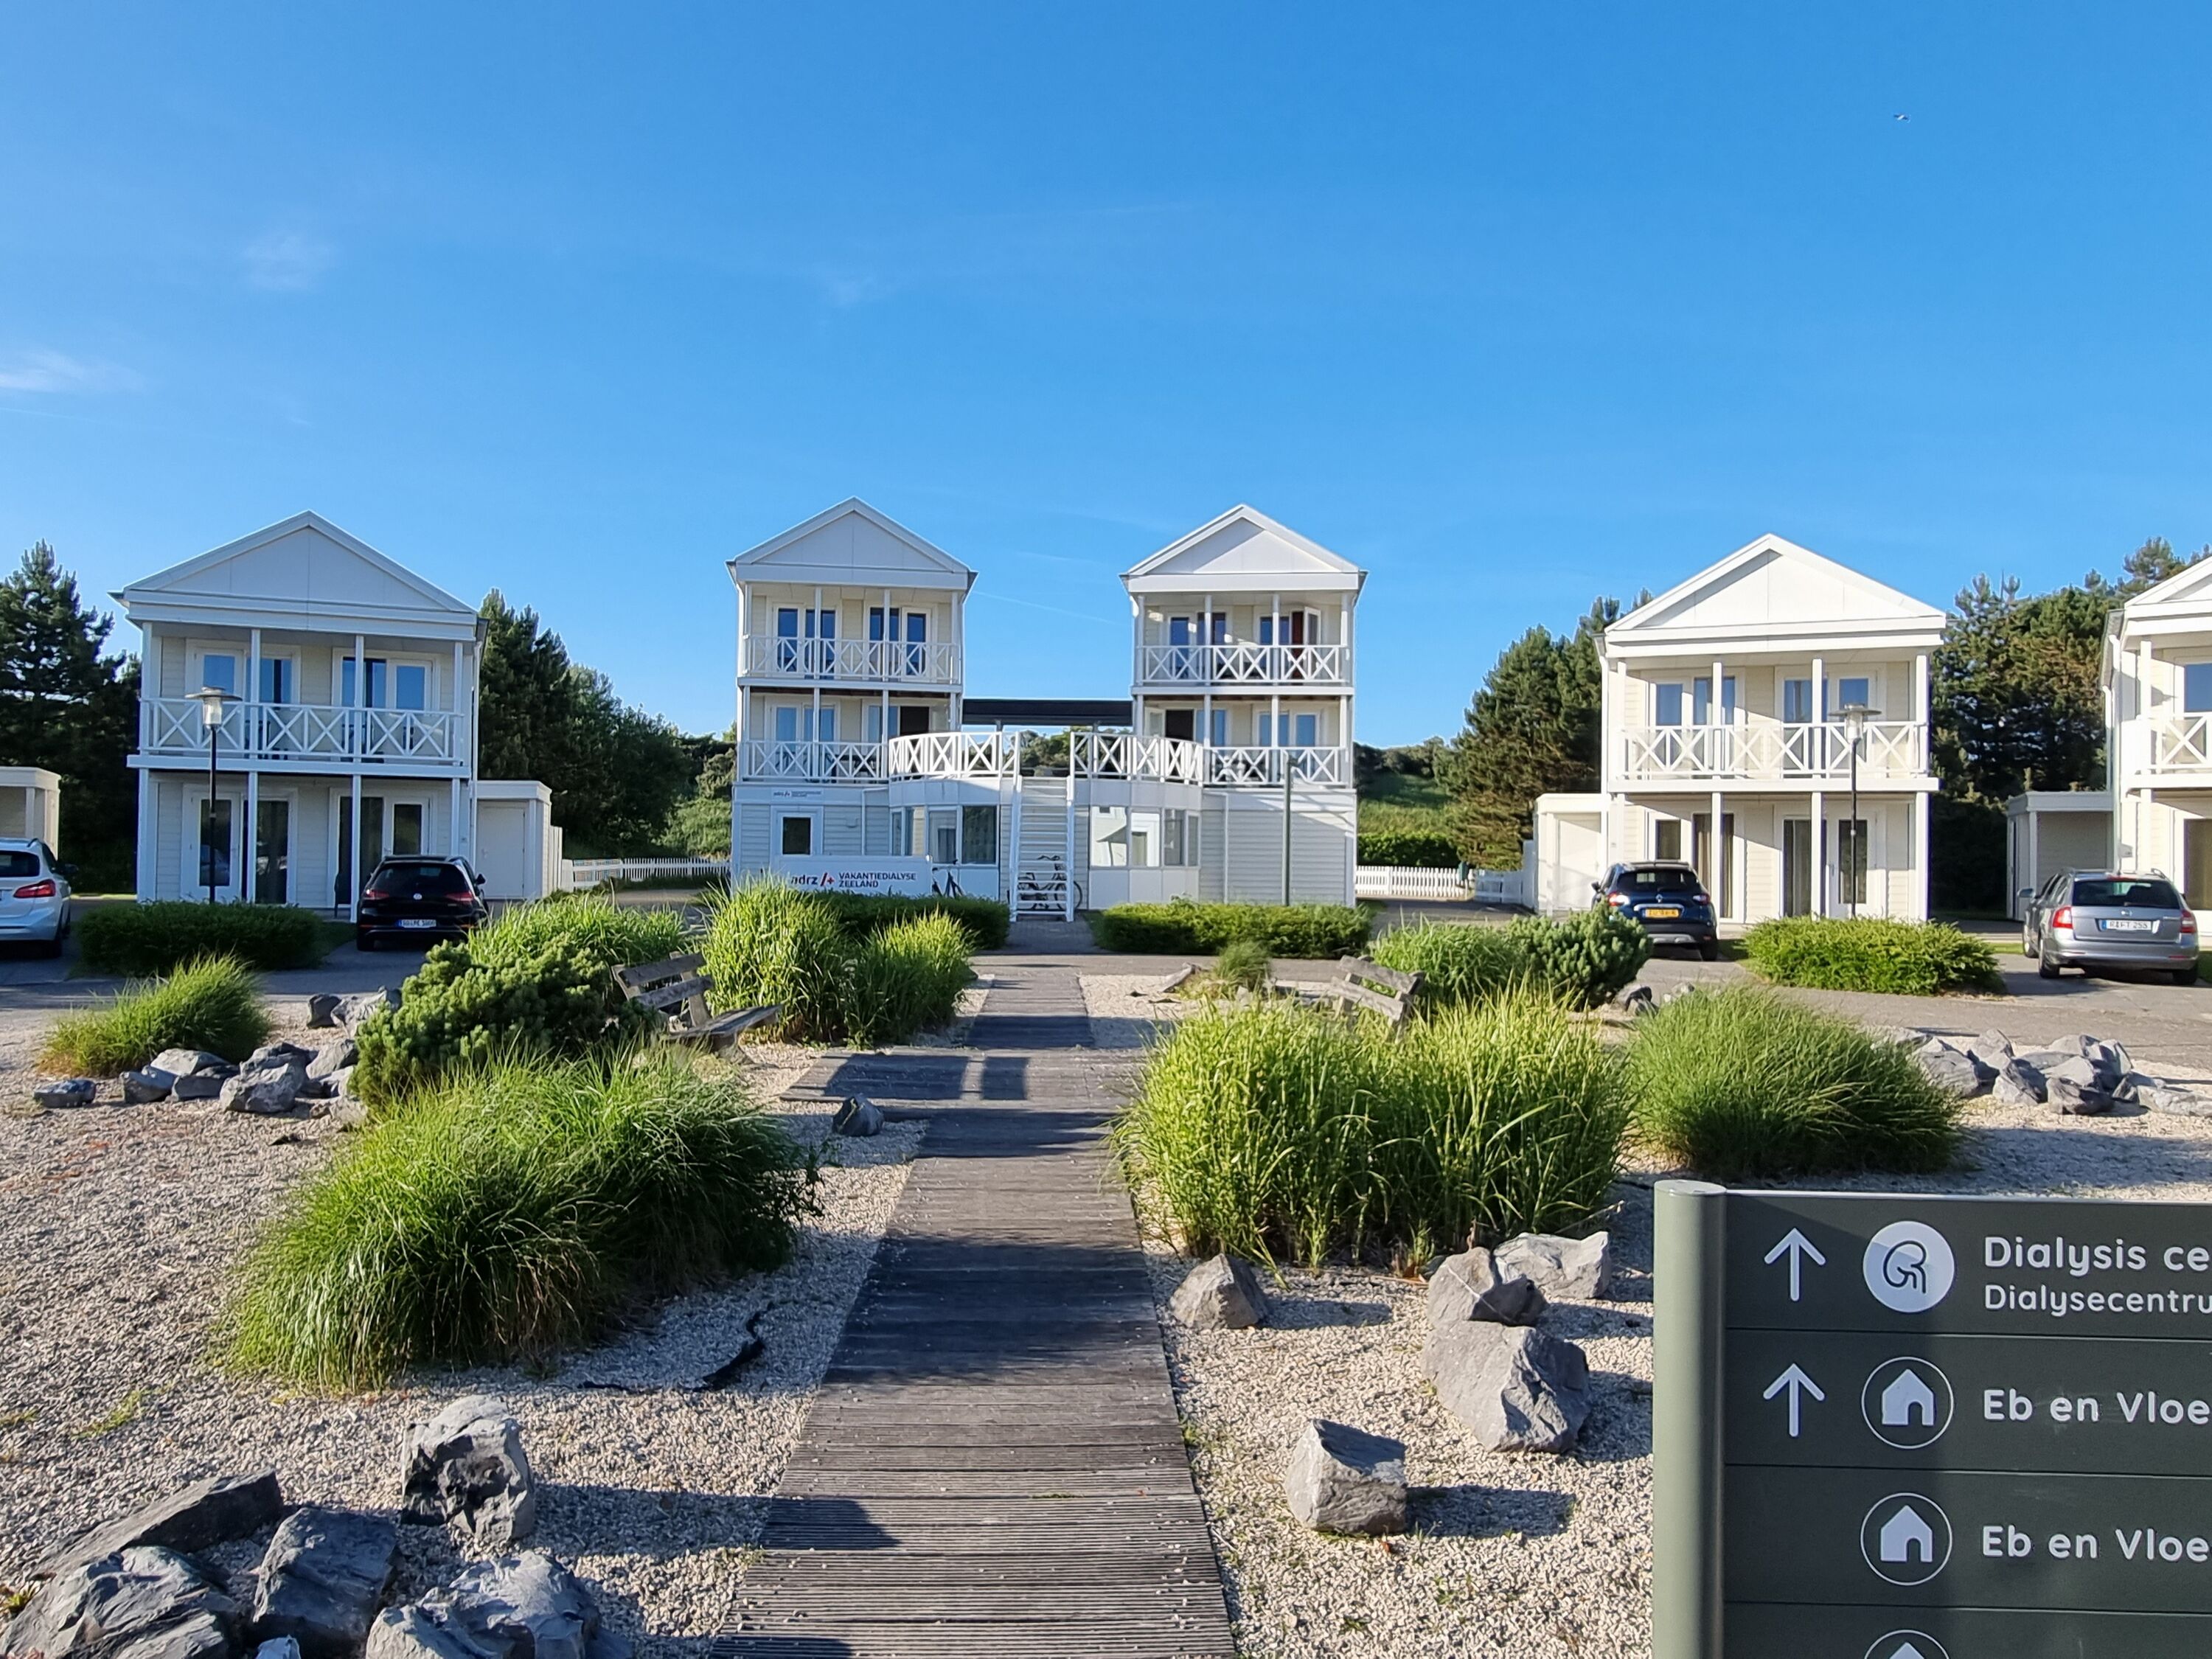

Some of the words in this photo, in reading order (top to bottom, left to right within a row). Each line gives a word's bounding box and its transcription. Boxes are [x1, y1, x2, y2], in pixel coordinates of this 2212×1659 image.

[838, 872, 917, 880] VAKANTIEDIALYSE
[1985, 1237, 2146, 1277] Dialysis
[2163, 1246, 2211, 1271] ce
[1985, 1284, 2212, 1317] Dialysecentru
[1983, 1388, 2033, 1422] Eb
[2050, 1397, 2099, 1422] en
[2116, 1391, 2211, 1425] Vloe
[1983, 1524, 2032, 1557] Eb
[2048, 1533, 2097, 1559] en
[2115, 1528, 2210, 1562] Vloe
